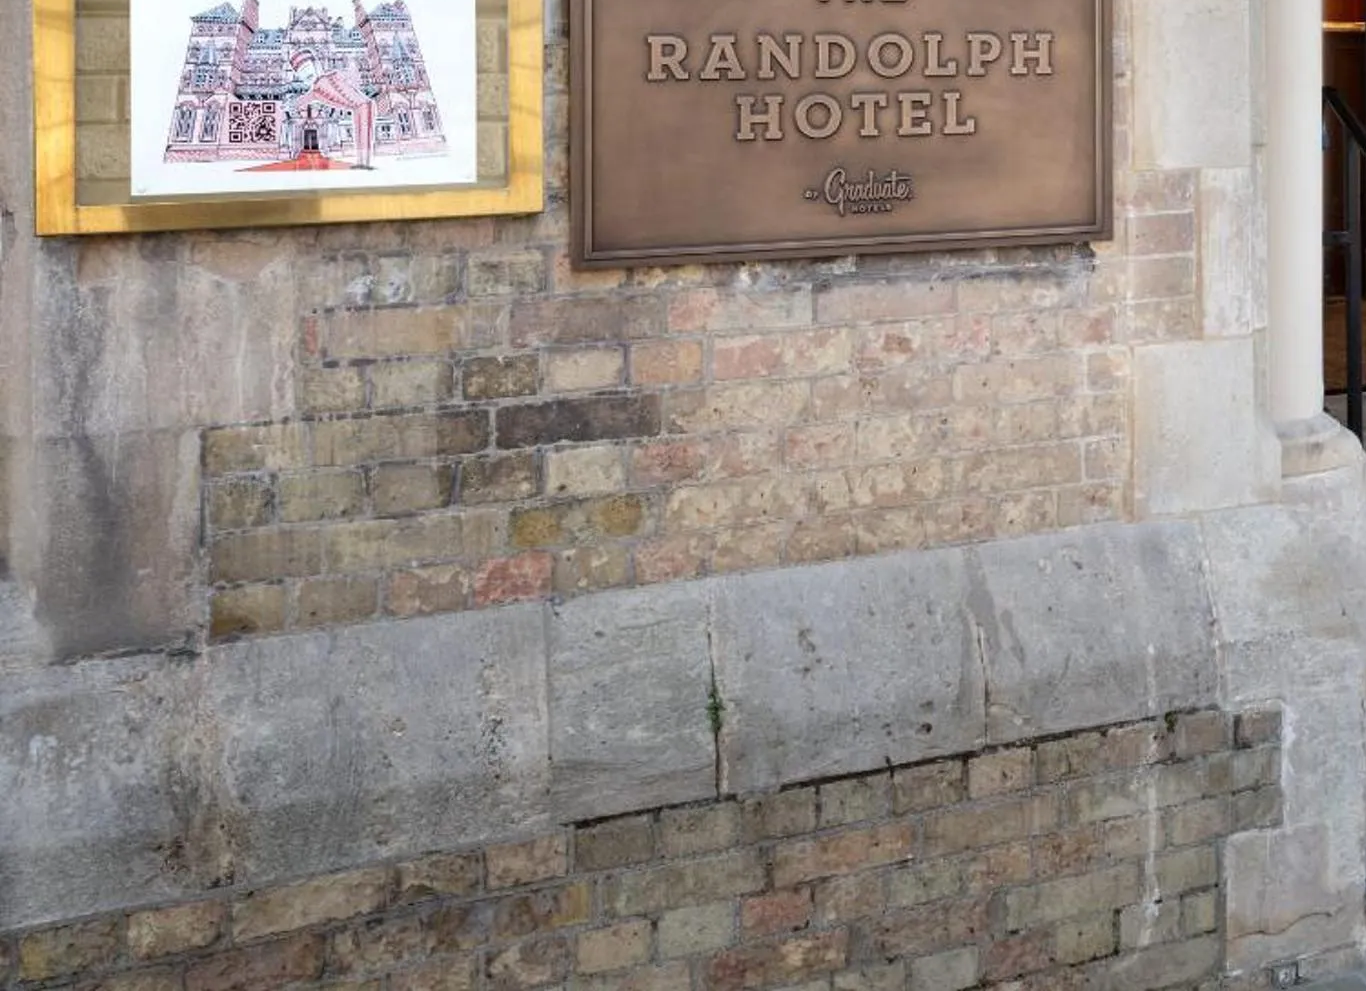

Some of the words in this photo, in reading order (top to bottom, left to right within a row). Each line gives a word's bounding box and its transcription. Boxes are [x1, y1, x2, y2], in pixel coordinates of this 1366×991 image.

[645, 31, 1054, 82] RANDOLPH
[735, 90, 977, 142] HOTEL
[823, 167, 912, 217] Graduate
